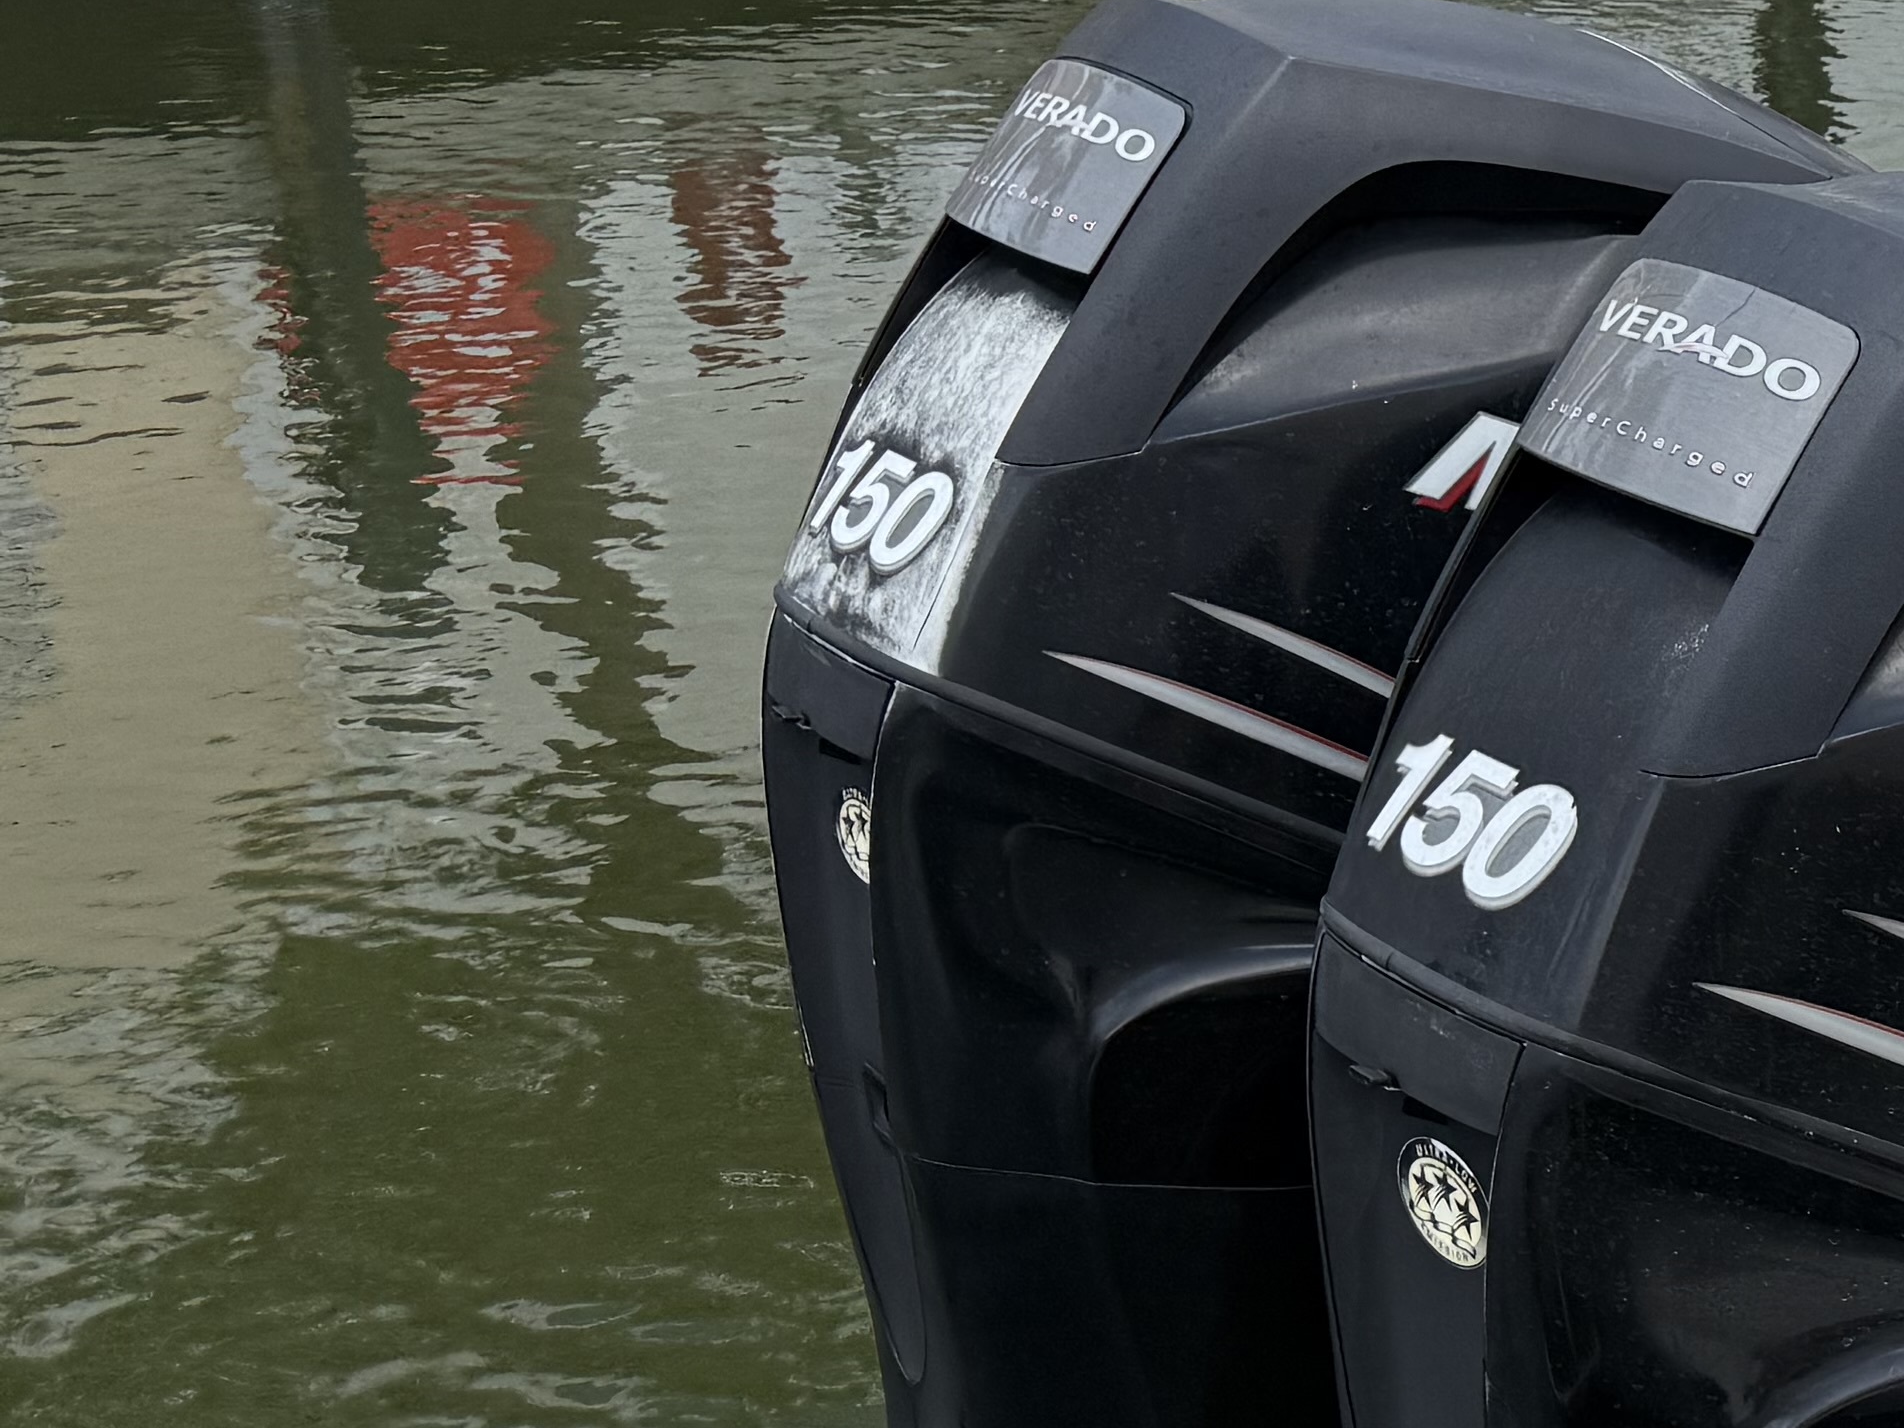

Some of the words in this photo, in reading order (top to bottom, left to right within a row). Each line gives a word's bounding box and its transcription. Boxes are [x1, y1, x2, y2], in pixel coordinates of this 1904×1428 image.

[1013, 88, 1156, 162] VERADO
[1599, 298, 1822, 402] VERADO
[1547, 397, 1755, 488] SuperCharged
[809, 438, 954, 575] 150
[1365, 733, 1579, 911] 150
